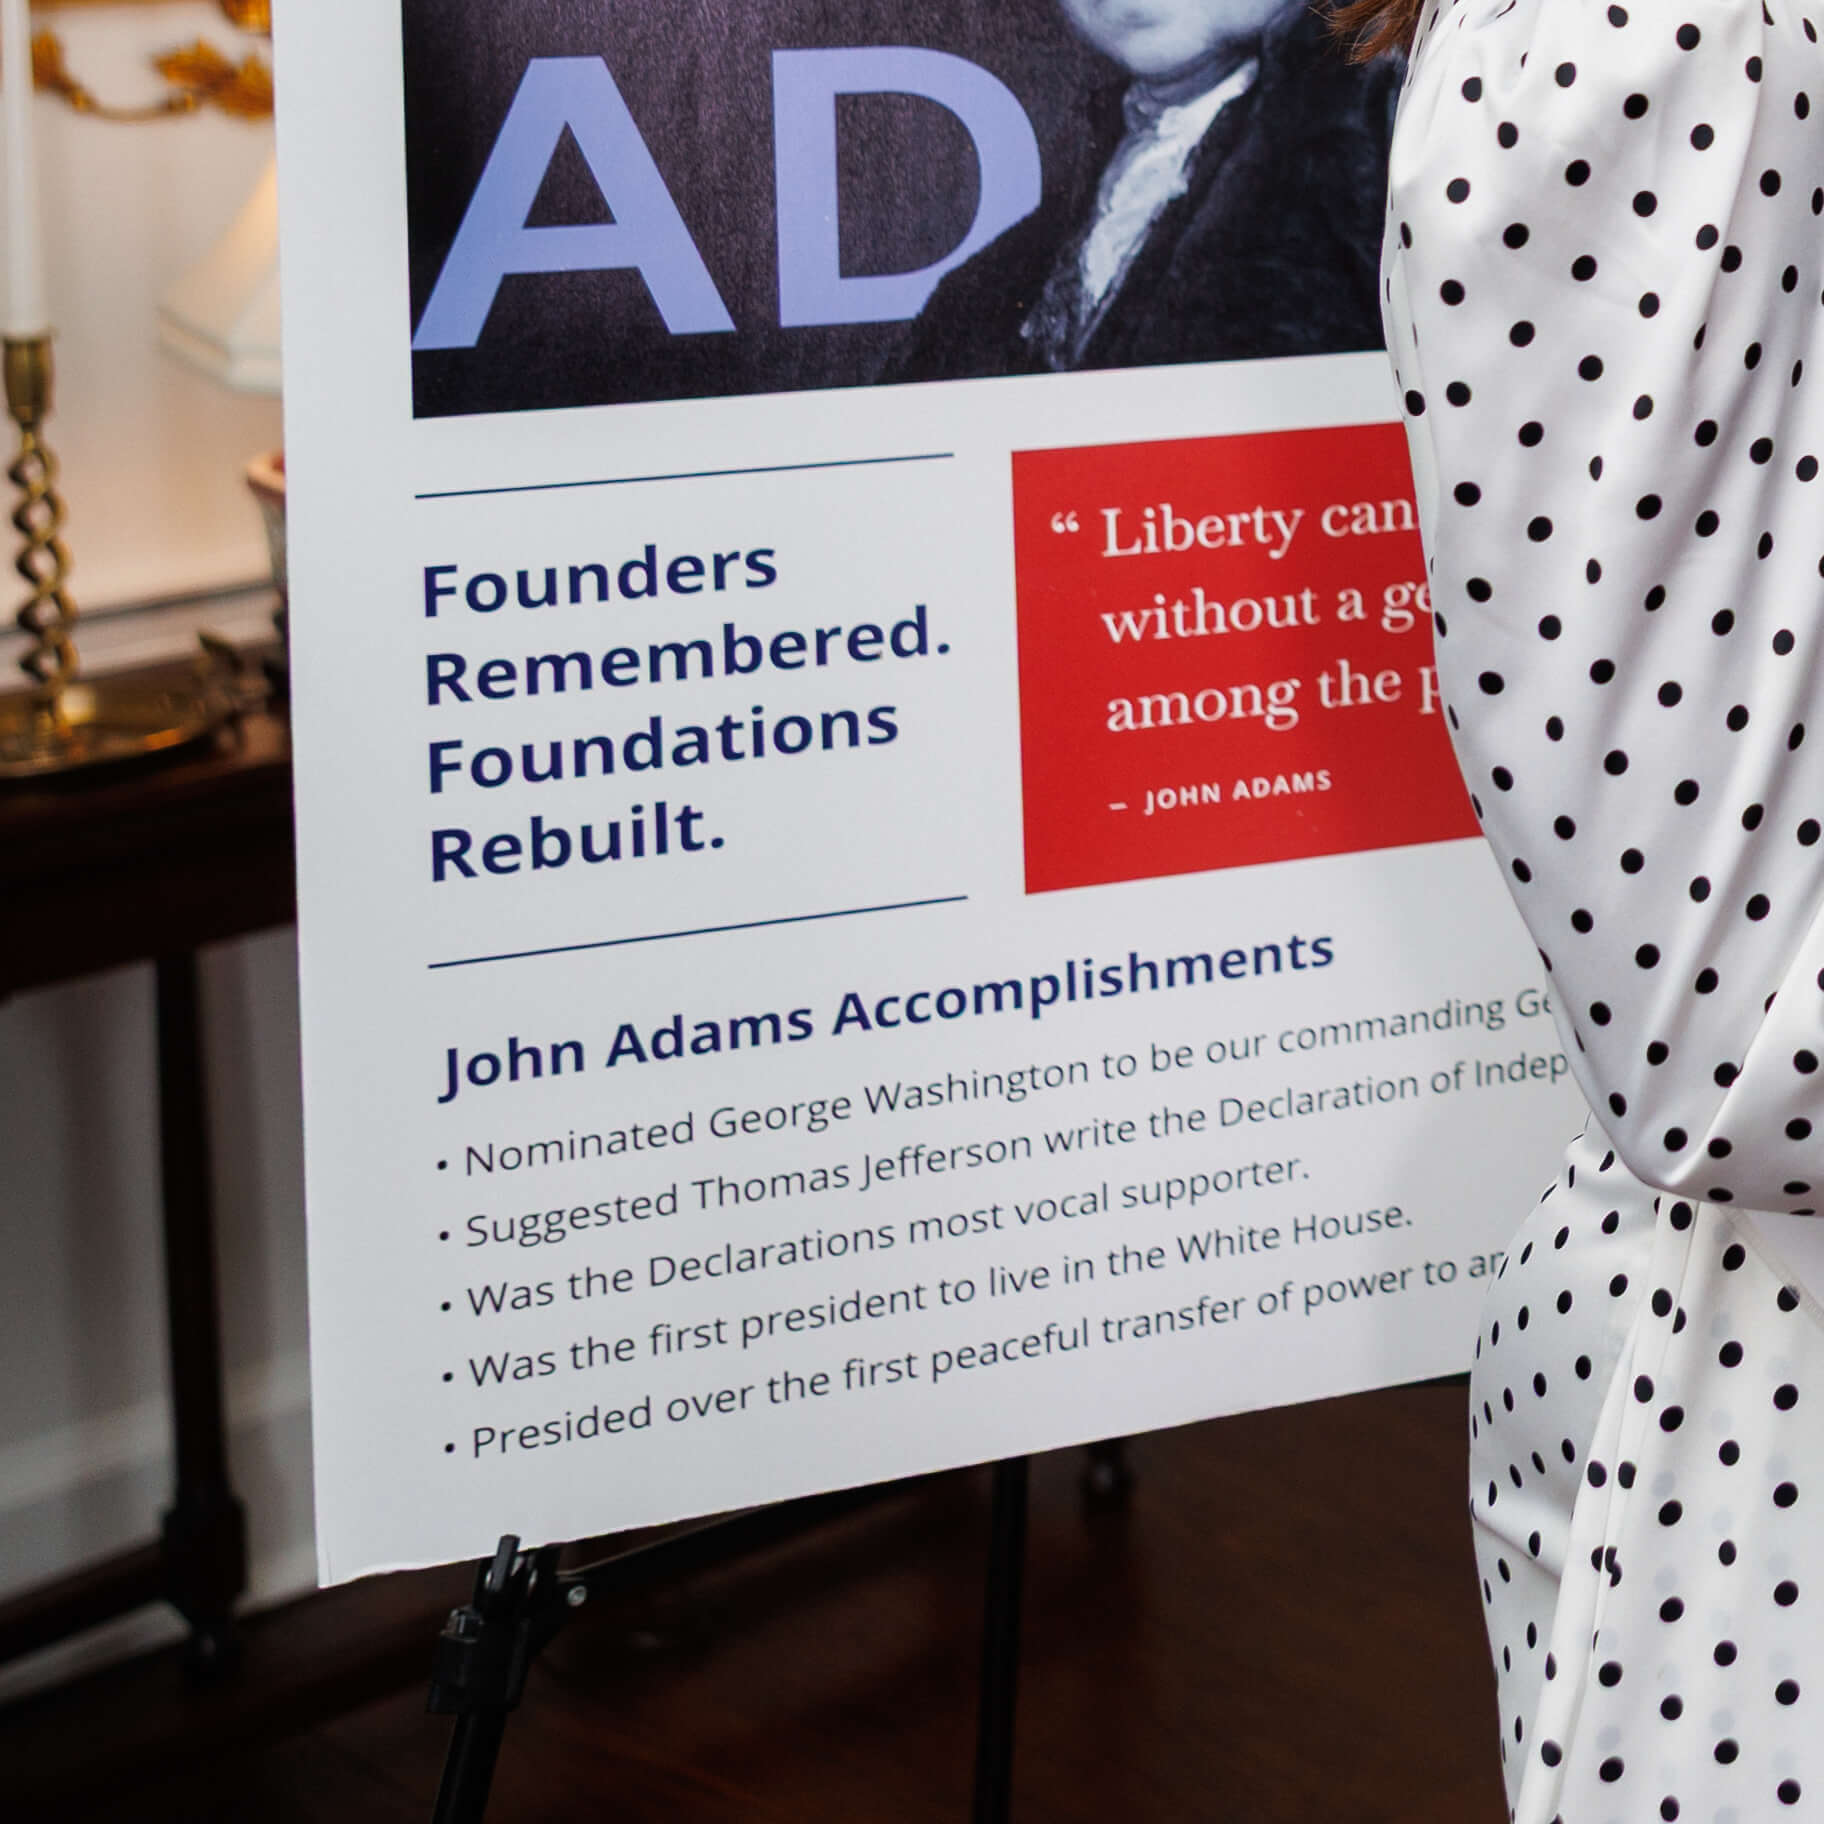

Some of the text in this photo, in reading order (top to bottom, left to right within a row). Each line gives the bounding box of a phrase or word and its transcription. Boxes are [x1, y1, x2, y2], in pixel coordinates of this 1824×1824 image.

[1101, 503, 1303, 559] Liberty
[424, 544, 776, 617] Founders
[1101, 587, 1319, 643] without
[1338, 589, 1365, 621] a
[427, 605, 949, 705] Remembered.
[1107, 679, 1300, 731] among
[1318, 659, 1400, 708] the
[430, 706, 898, 794] Foundations
[1144, 783, 1220, 815] JOHN
[1232, 770, 1331, 800] ADAMS
[432, 802, 724, 882] Rebuilt.
[438, 936, 1333, 1104] John Adams Accomplishments
[467, 1112, 693, 1176] Nominated
[710, 1097, 851, 1138] George
[864, 1063, 1087, 1114] Washington
[1103, 1055, 1136, 1079] to
[1152, 1044, 1192, 1072] be
[1207, 1035, 1266, 1063] our
[1280, 1000, 1505, 1052] commanding
[467, 1184, 677, 1247] Suggested
[691, 1165, 849, 1208] Thomas
[859, 1137, 1030, 1191] Jefferson
[1044, 1120, 1135, 1153] write
[1149, 1107, 1205, 1138] the
[1221, 1077, 1418, 1127] Declaration
[1431, 1061, 1464, 1094] of
[467, 1160, 1308, 1316] Was the Declarations most vocal supporter.
[469, 1207, 1412, 1387] Was the first president to live in the White House.
[474, 1396, 651, 1458] Presided
[667, 1386, 754, 1421] over
[768, 1371, 829, 1404] the
[843, 1354, 917, 1390] first
[933, 1318, 1088, 1383] peaceful
[1102, 1296, 1245, 1343] transfer
[1258, 1281, 1293, 1315] of
[1305, 1268, 1412, 1315] power
[1424, 1262, 1456, 1285] to
